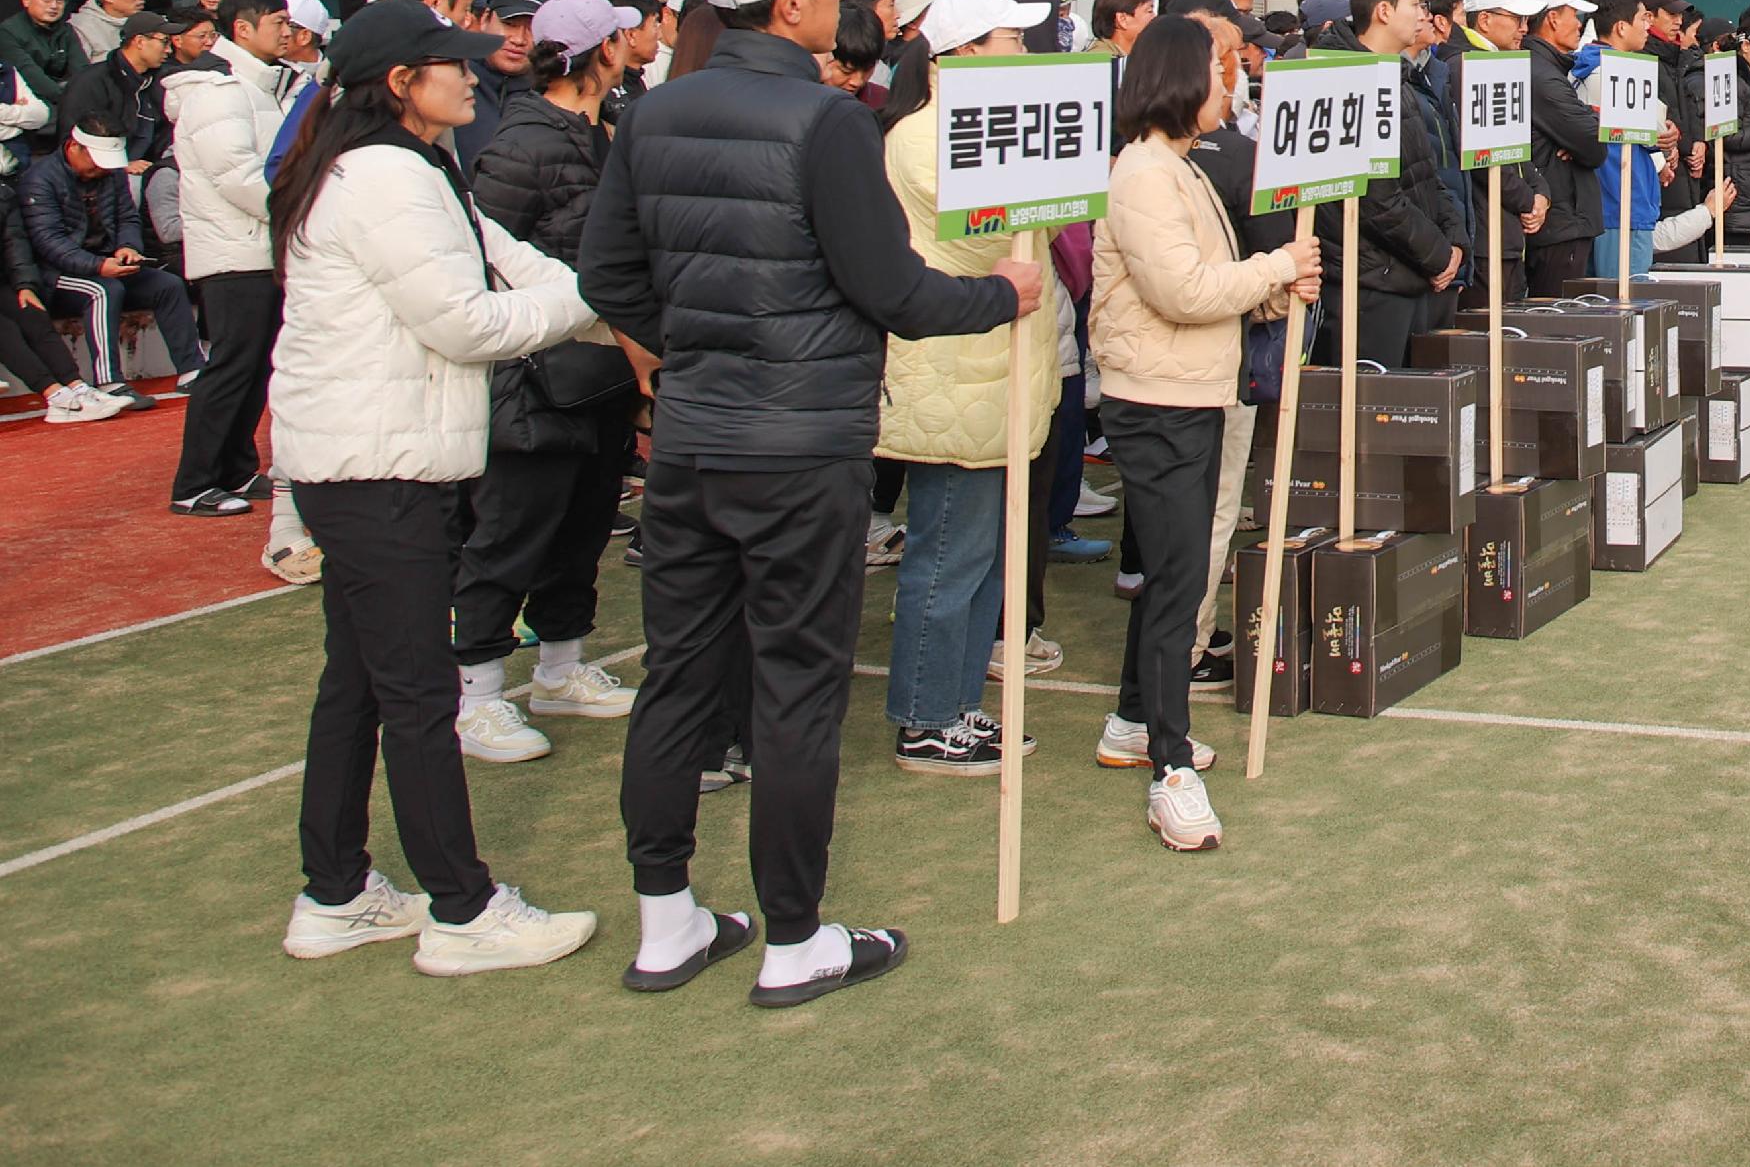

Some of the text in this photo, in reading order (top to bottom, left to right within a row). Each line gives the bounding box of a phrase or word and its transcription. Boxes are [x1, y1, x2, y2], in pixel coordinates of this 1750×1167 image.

[1610, 75, 1651, 110] TOP
[1273, 92, 1364, 157] 여성회
[1010, 199, 1088, 226] 남양주시테니스협회
[1478, 541, 1496, 587] 먹골배
[1323, 606, 1344, 657] 먹골배
